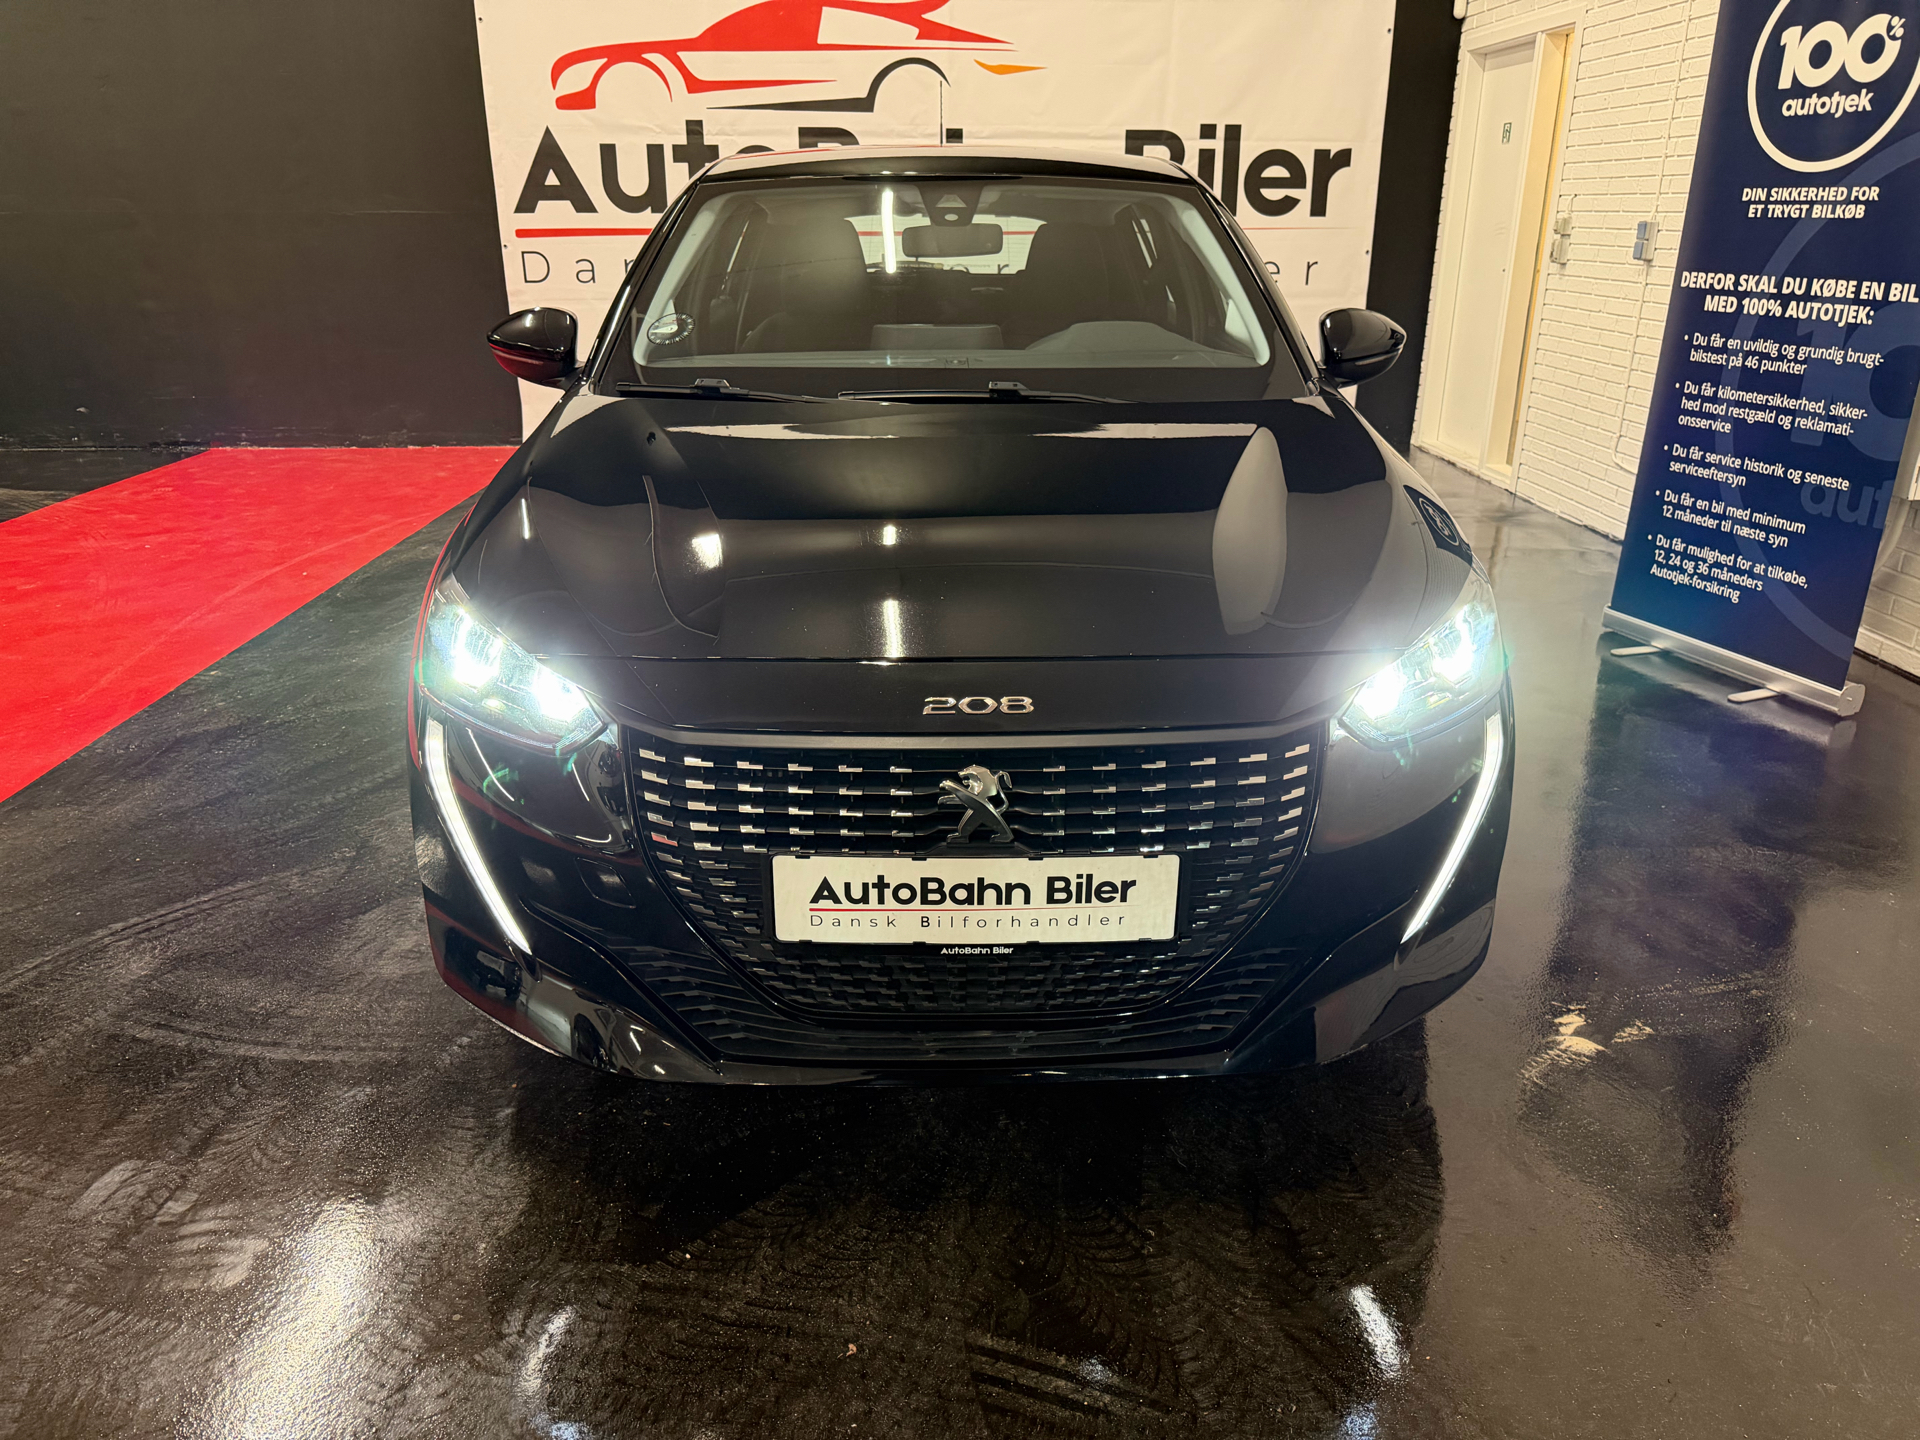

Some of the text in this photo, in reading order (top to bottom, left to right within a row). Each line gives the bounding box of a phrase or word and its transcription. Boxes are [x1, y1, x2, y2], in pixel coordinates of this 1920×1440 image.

[1778, 13, 1906, 89] 100%
[1781, 88, 1874, 119] autotjek
[1742, 186, 1880, 202] DIN SIKKERHED FOR
[1748, 204, 1866, 220] ET TRYGT BILKØB
[1680, 272, 1919, 302] DERFOR SKAL DU KØBE EN BIL
[1704, 294, 1874, 327] MED 100% AUTOTJEK:
[1690, 348, 1807, 375] bilstest på 46 punkter
[1692, 333, 1884, 369] Du får en uvildig og grundig brugt-
[1681, 396, 1854, 436] hed mod restgæld og reklamati-
[1684, 380, 1868, 420] Du får kilometersikkerhed, sikker-
[1678, 414, 1732, 433] onsservice
[1669, 461, 1746, 488] serviceeftersyn
[1672, 444, 1850, 491] Du får service historik og seneste
[1662, 505, 1788, 548] 12 måneder til næste syn
[1664, 490, 1806, 534] Du får en bil med minimum
[1654, 550, 1763, 591] 12, 24 og 36 måneders
[1656, 534, 1808, 588] Du får mulighed for at tilkøbe,
[1650, 564, 1740, 603] Autotjek-forsikring
[922, 696, 1034, 715] 208
[809, 874, 1137, 906] AutoBahn Biler
[810, 913, 1126, 928] Dansk Bilforhandler
[940, 946, 1014, 954] AutoBahn Biler
